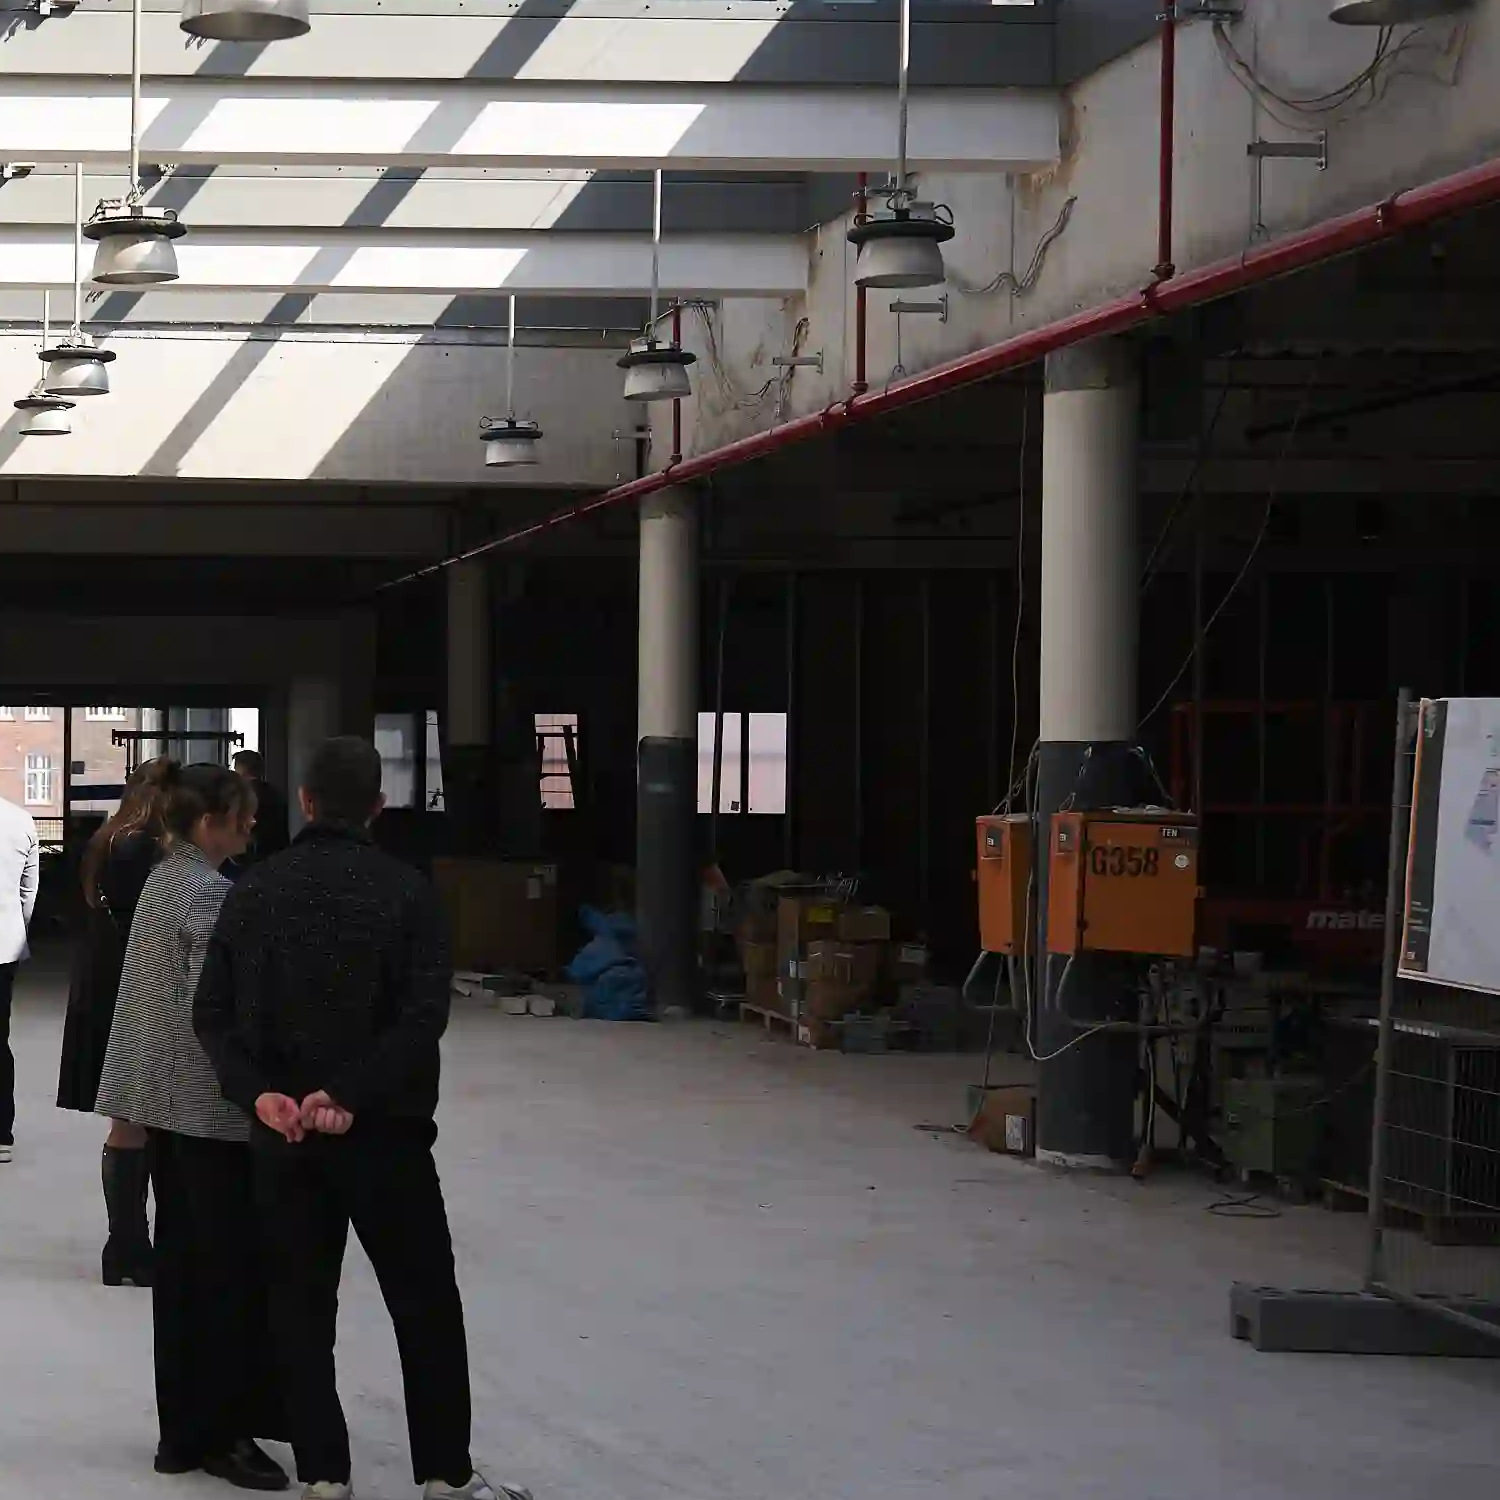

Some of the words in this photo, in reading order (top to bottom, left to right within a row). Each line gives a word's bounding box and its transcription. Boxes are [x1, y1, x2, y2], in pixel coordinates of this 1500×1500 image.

[1161, 828, 1178, 837] TEN
[1091, 845, 1159, 877] G358
[1306, 909, 1385, 929] mate
